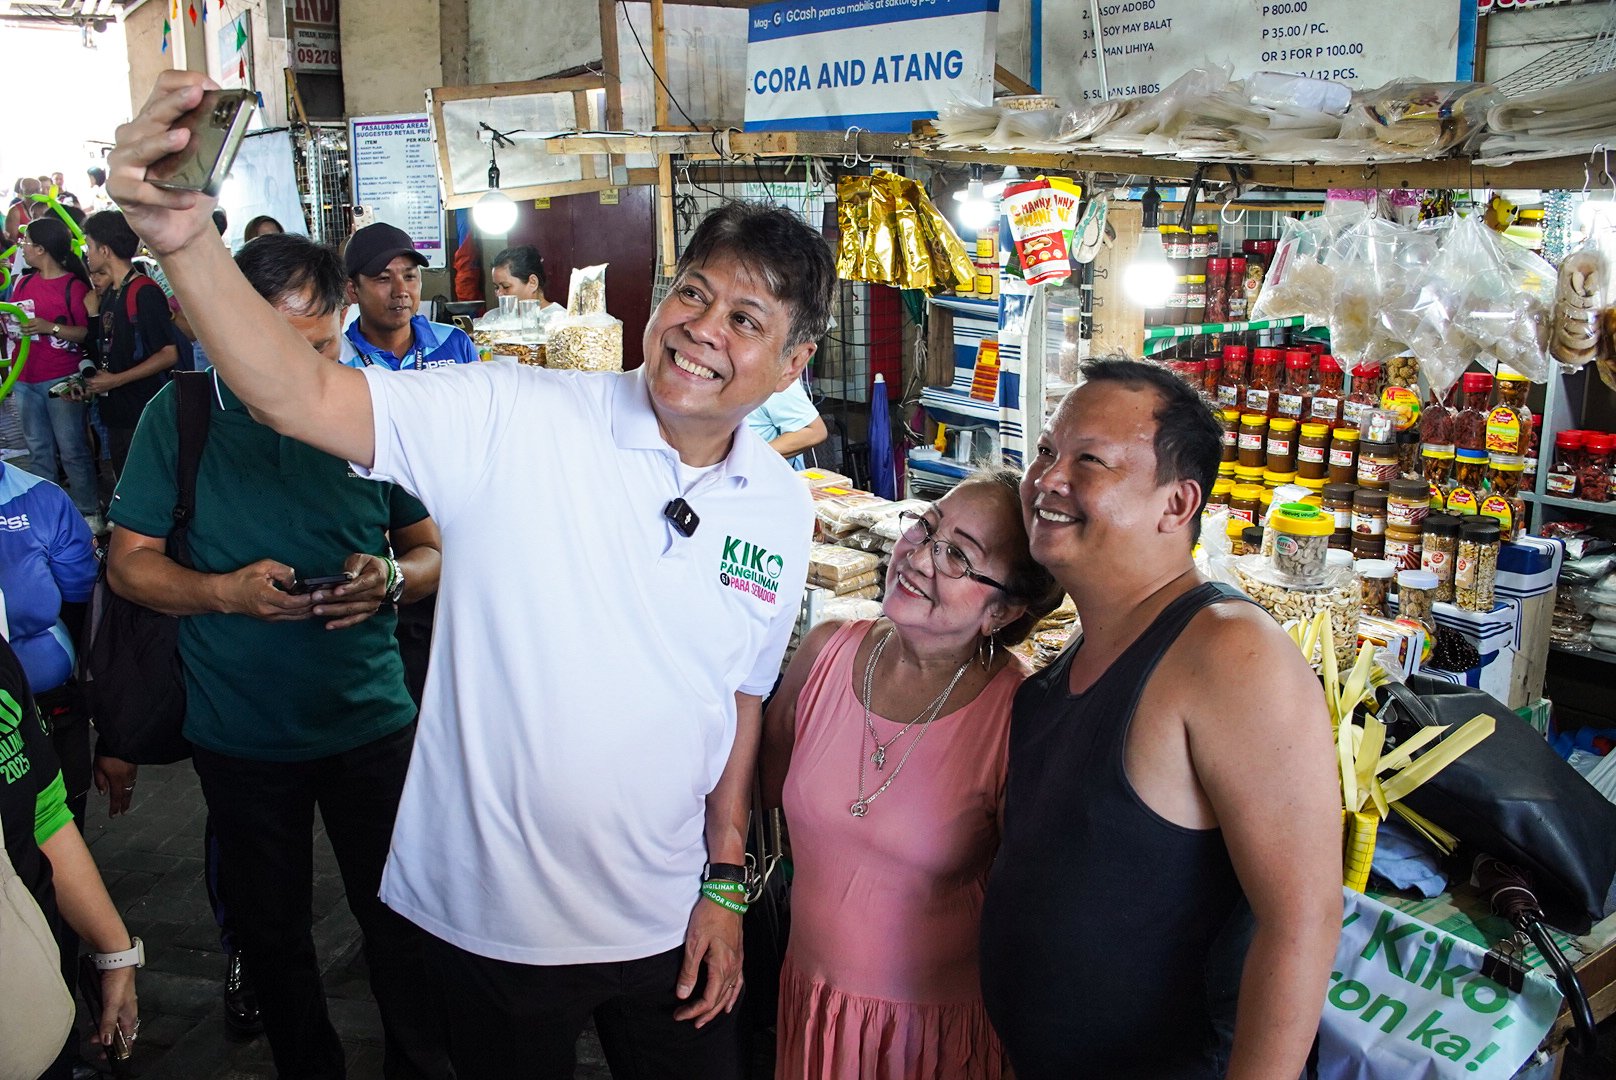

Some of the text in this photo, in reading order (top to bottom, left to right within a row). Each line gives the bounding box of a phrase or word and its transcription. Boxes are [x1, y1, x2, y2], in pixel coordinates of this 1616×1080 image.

[754, 19, 771, 29] Mag-
[787, 8, 816, 22] GCash
[819, 8, 835, 20] para
[836, 7, 846, 15] sa
[847, 1, 874, 14] mabilis
[1122, 0, 1155, 13] ADOBO
[1263, 1, 1307, 16] P 800.00
[1083, 30, 1090, 39] 3.
[1122, 23, 1141, 34] MAY
[1143, 18, 1172, 31] BALAT
[1262, 29, 1269, 39] P
[1272, 25, 1300, 38] 35.00
[1311, 22, 1328, 34] PC.
[1083, 42, 1154, 59] 4. SMAN LIHIYA
[1262, 43, 1363, 62] OR 3 FOR P 100.00
[754, 50, 963, 94] CORA AND ATANG
[1317, 70, 1329, 80] 12
[1333, 68, 1358, 79] PCS.
[1084, 90, 1091, 99] 5.
[1125, 86, 1136, 95] SA
[1138, 84, 1160, 95] IBOS
[361, 123, 405, 131] PASALUBONG
[1021, 197, 1051, 214] MANNY
[720, 561, 779, 592] PANGILINAN
[730, 577, 750, 592] PARA
[751, 583, 776, 604] SENADOR
[1360, 910, 1515, 1030] Kiko,
[1406, 1009, 1501, 1071] ka!
